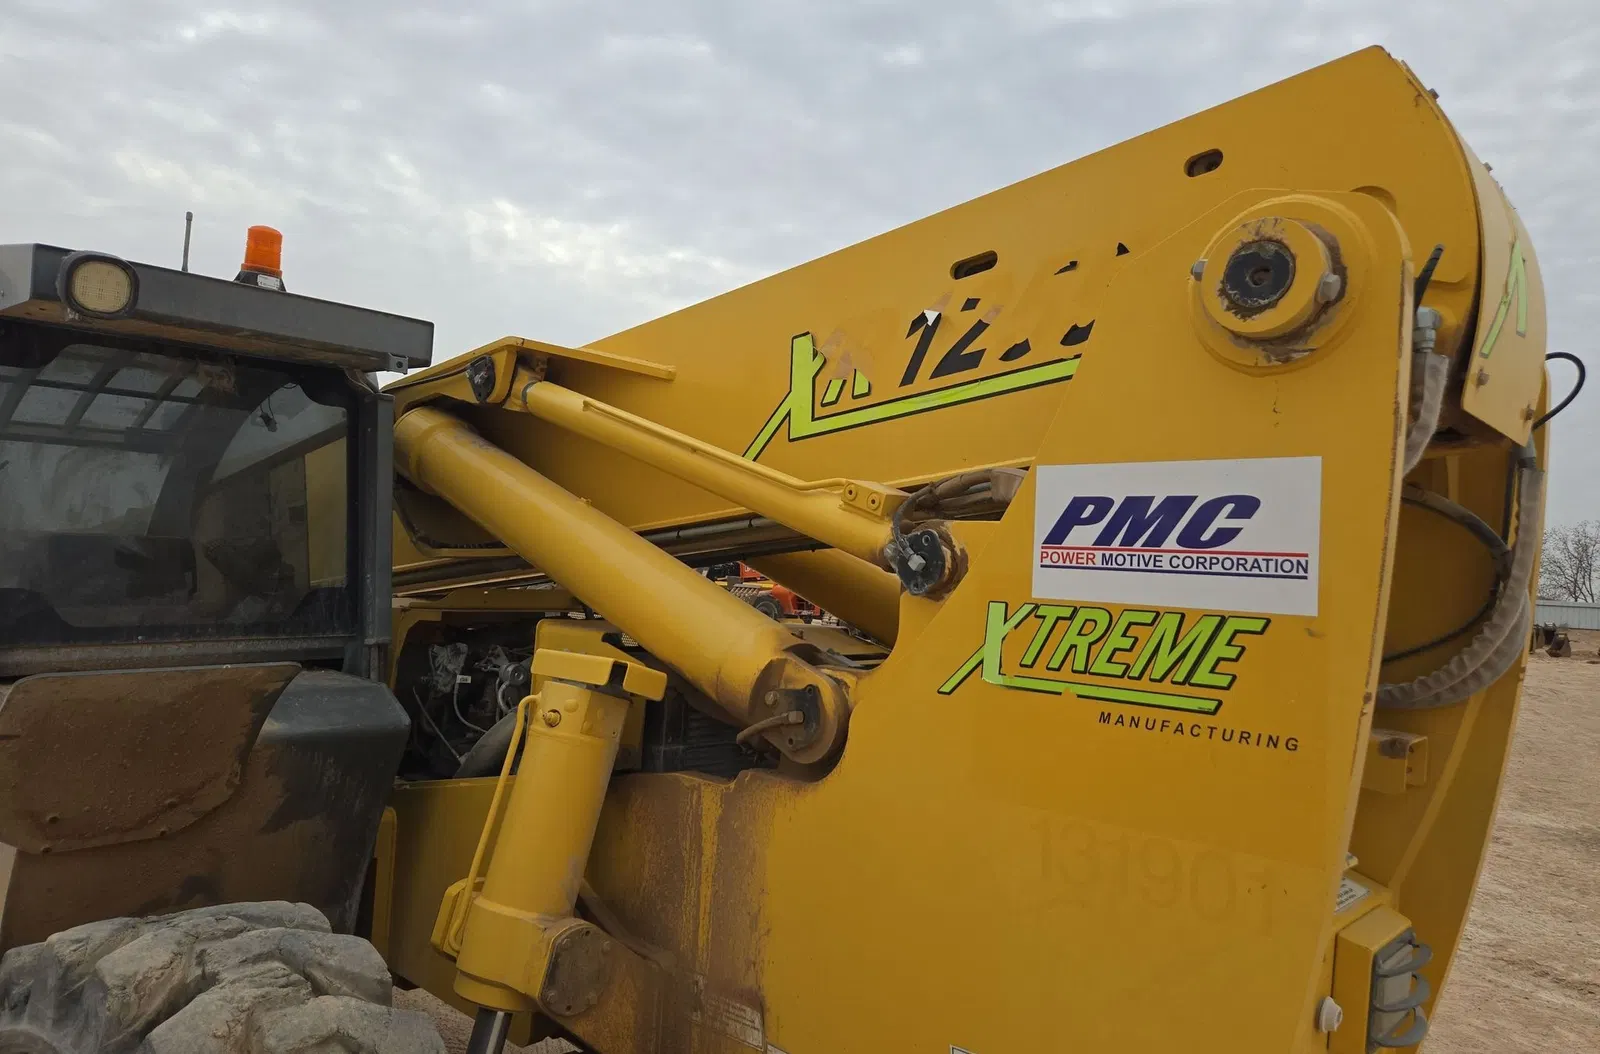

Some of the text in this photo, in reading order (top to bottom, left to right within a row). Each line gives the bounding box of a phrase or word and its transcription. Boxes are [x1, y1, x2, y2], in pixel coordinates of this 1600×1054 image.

[1041, 494, 1261, 549] PMC
[1040, 551, 1309, 575] POWER MOTIVE CORPORATION
[937, 600, 1271, 694] XTREME
[1098, 711, 1300, 752] MANUFACTURING
